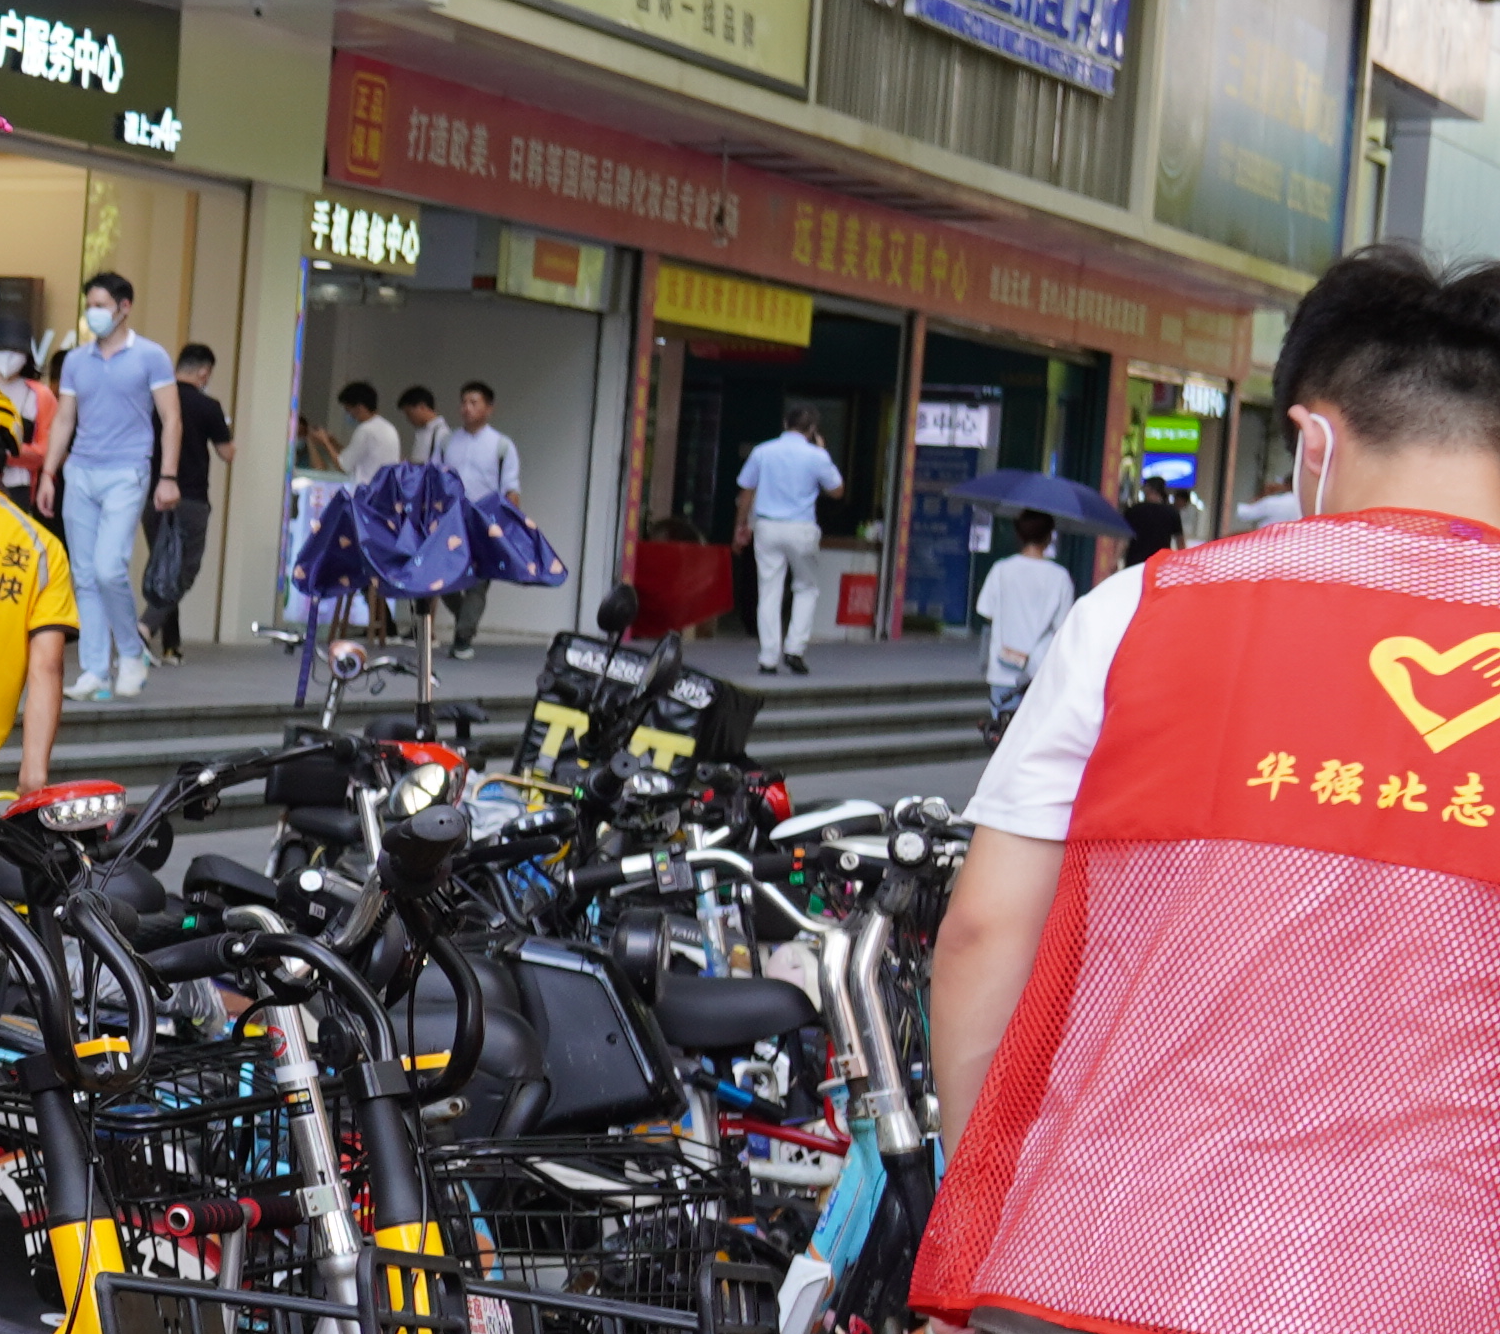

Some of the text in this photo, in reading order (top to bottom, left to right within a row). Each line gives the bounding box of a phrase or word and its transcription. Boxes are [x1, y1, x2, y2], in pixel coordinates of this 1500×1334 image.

[311, 200, 420, 265] 手机维修中心
[1247, 751, 1495, 827] 华强北志
